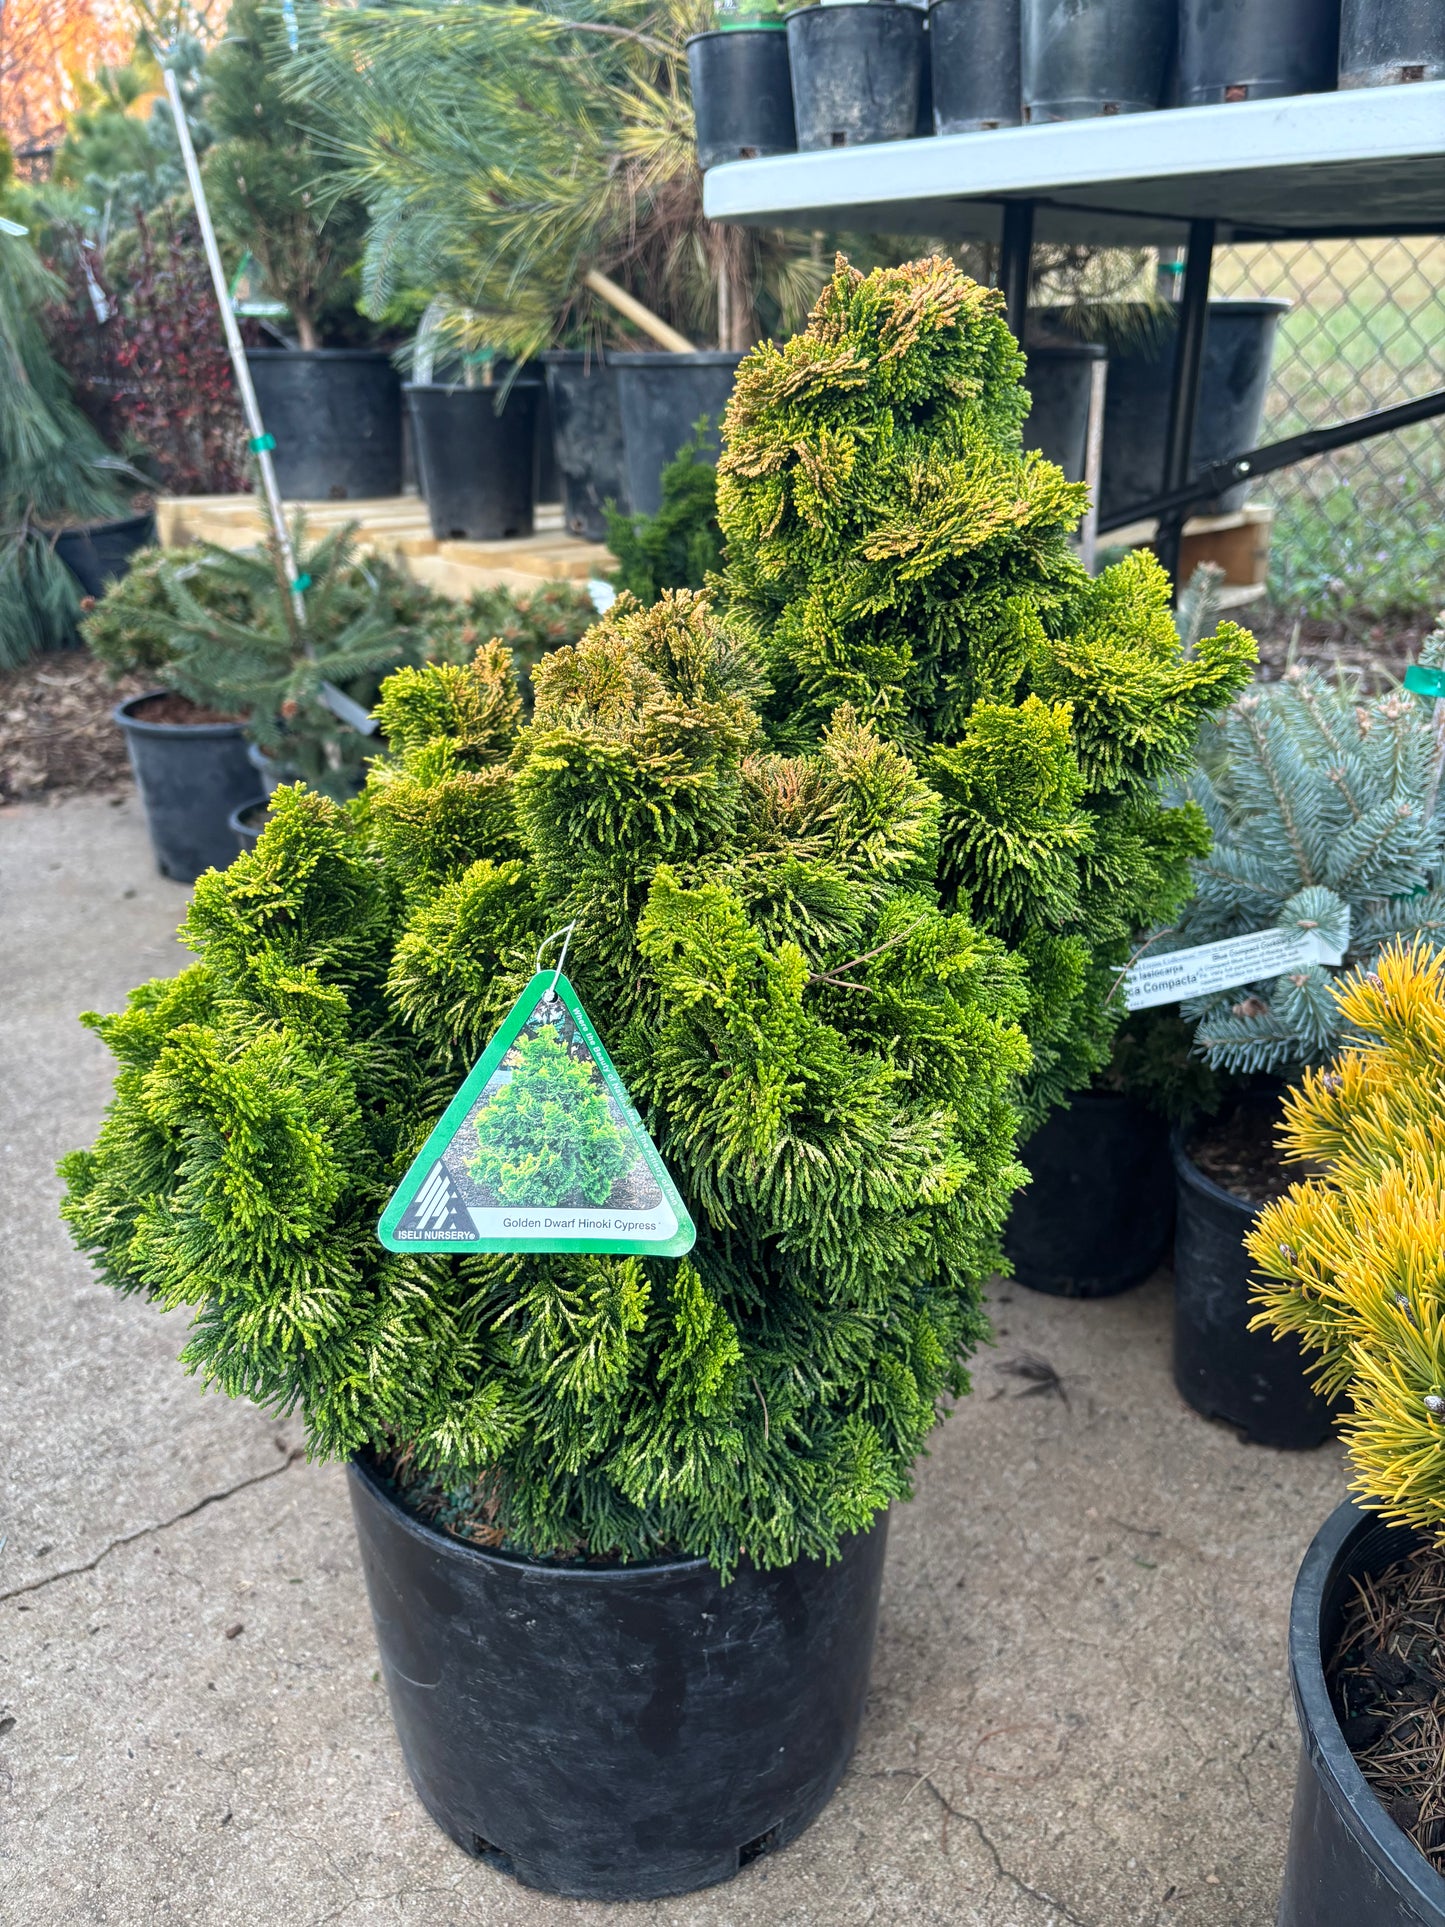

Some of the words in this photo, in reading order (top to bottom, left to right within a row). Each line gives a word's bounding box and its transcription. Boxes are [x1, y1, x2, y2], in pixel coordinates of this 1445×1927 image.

[573, 1007, 588, 1032] Where
[586, 1032, 596, 1046] the
[593, 1046, 610, 1072] Beauty
[607, 1073, 617, 1081] of
[626, 1109, 641, 1133] Mees
[639, 1133, 649, 1148] The
[646, 1149, 664, 1177] Artistry
[662, 1179, 670, 1187] of
[503, 1217, 541, 1228] Golden
[544, 1218, 575, 1228] Dwarf
[578, 1218, 611, 1229] Hinoki
[614, 1219, 656, 1232] Cypress
[398, 1230, 422, 1240] ISELI
